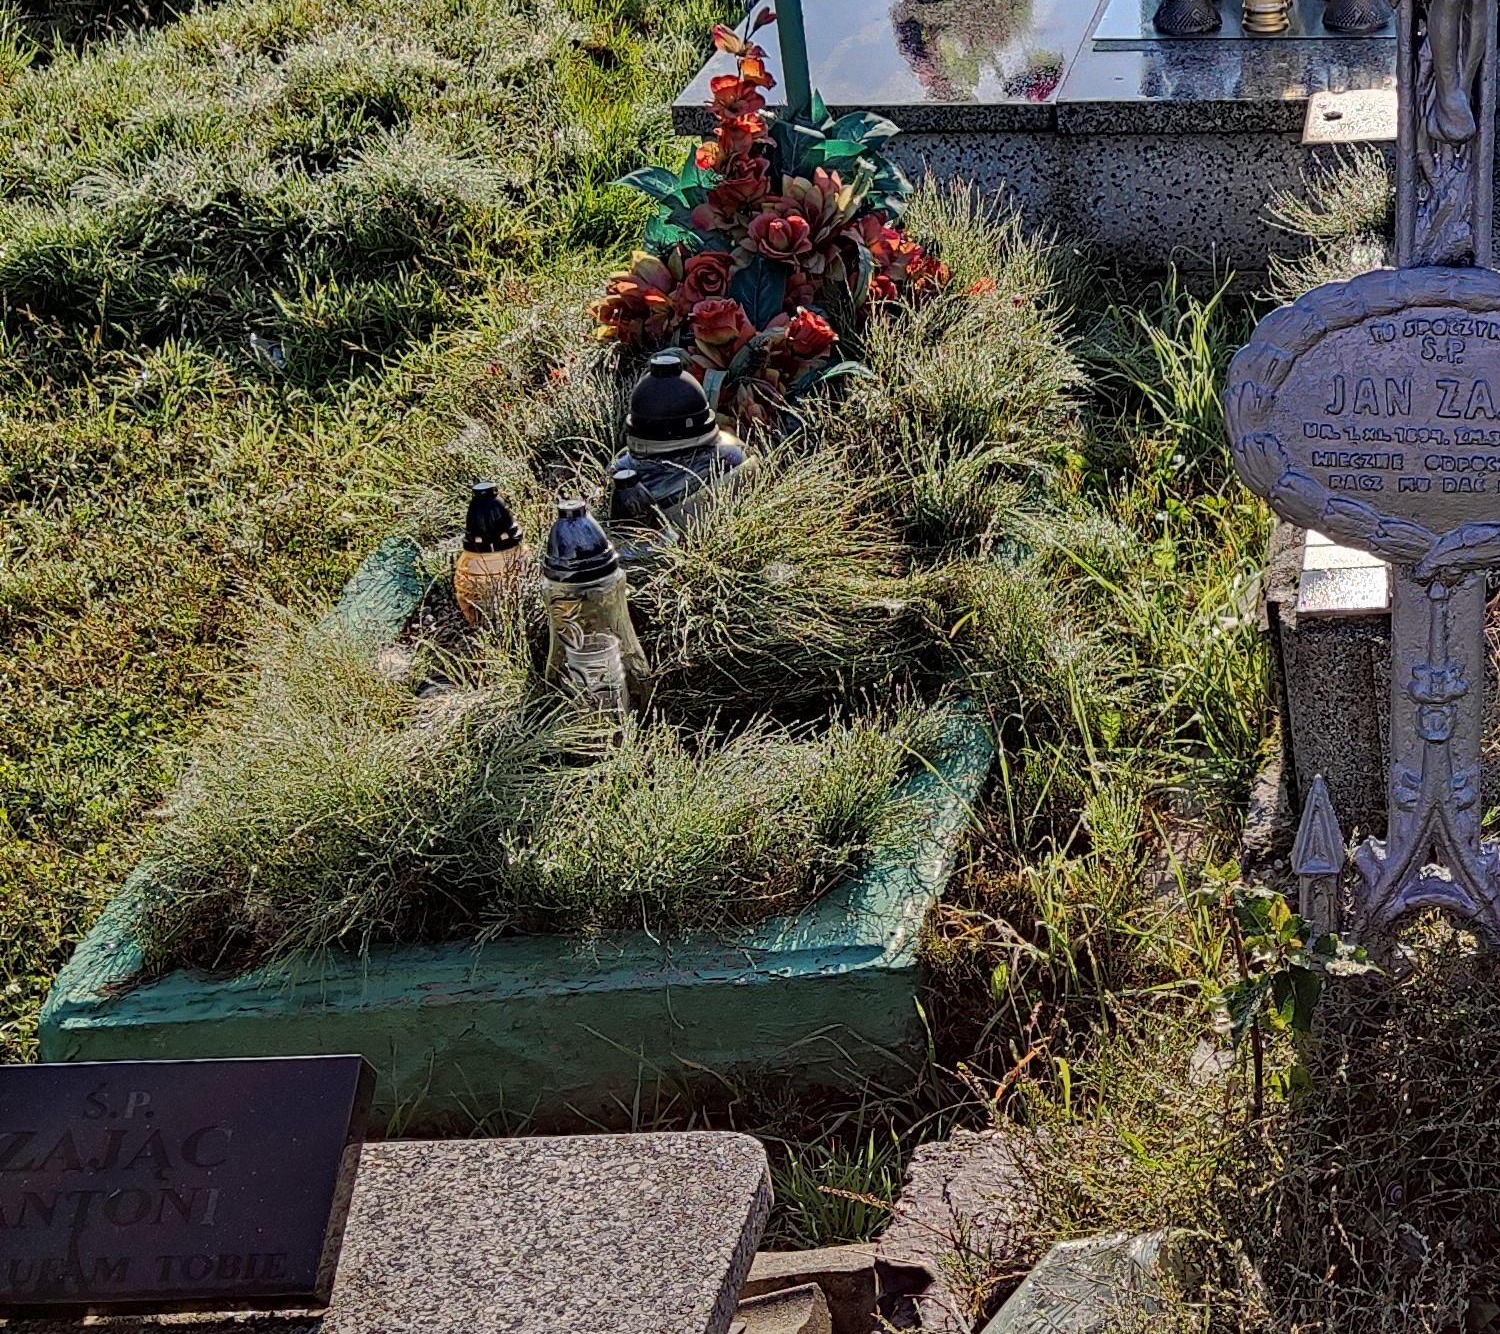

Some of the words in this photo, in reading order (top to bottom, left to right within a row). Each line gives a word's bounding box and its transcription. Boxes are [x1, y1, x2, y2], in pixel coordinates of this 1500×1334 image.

[1326, 375, 1412, 416] JAN
[1312, 451, 1404, 469] WIECZNE
[1329, 474, 1383, 492] RACZ
[1398, 477, 1432, 493] MU
[1442, 471, 1486, 493] DAĆ
[0, 1187, 221, 1229] NTONI
[155, 1252, 289, 1283] TOBIE
